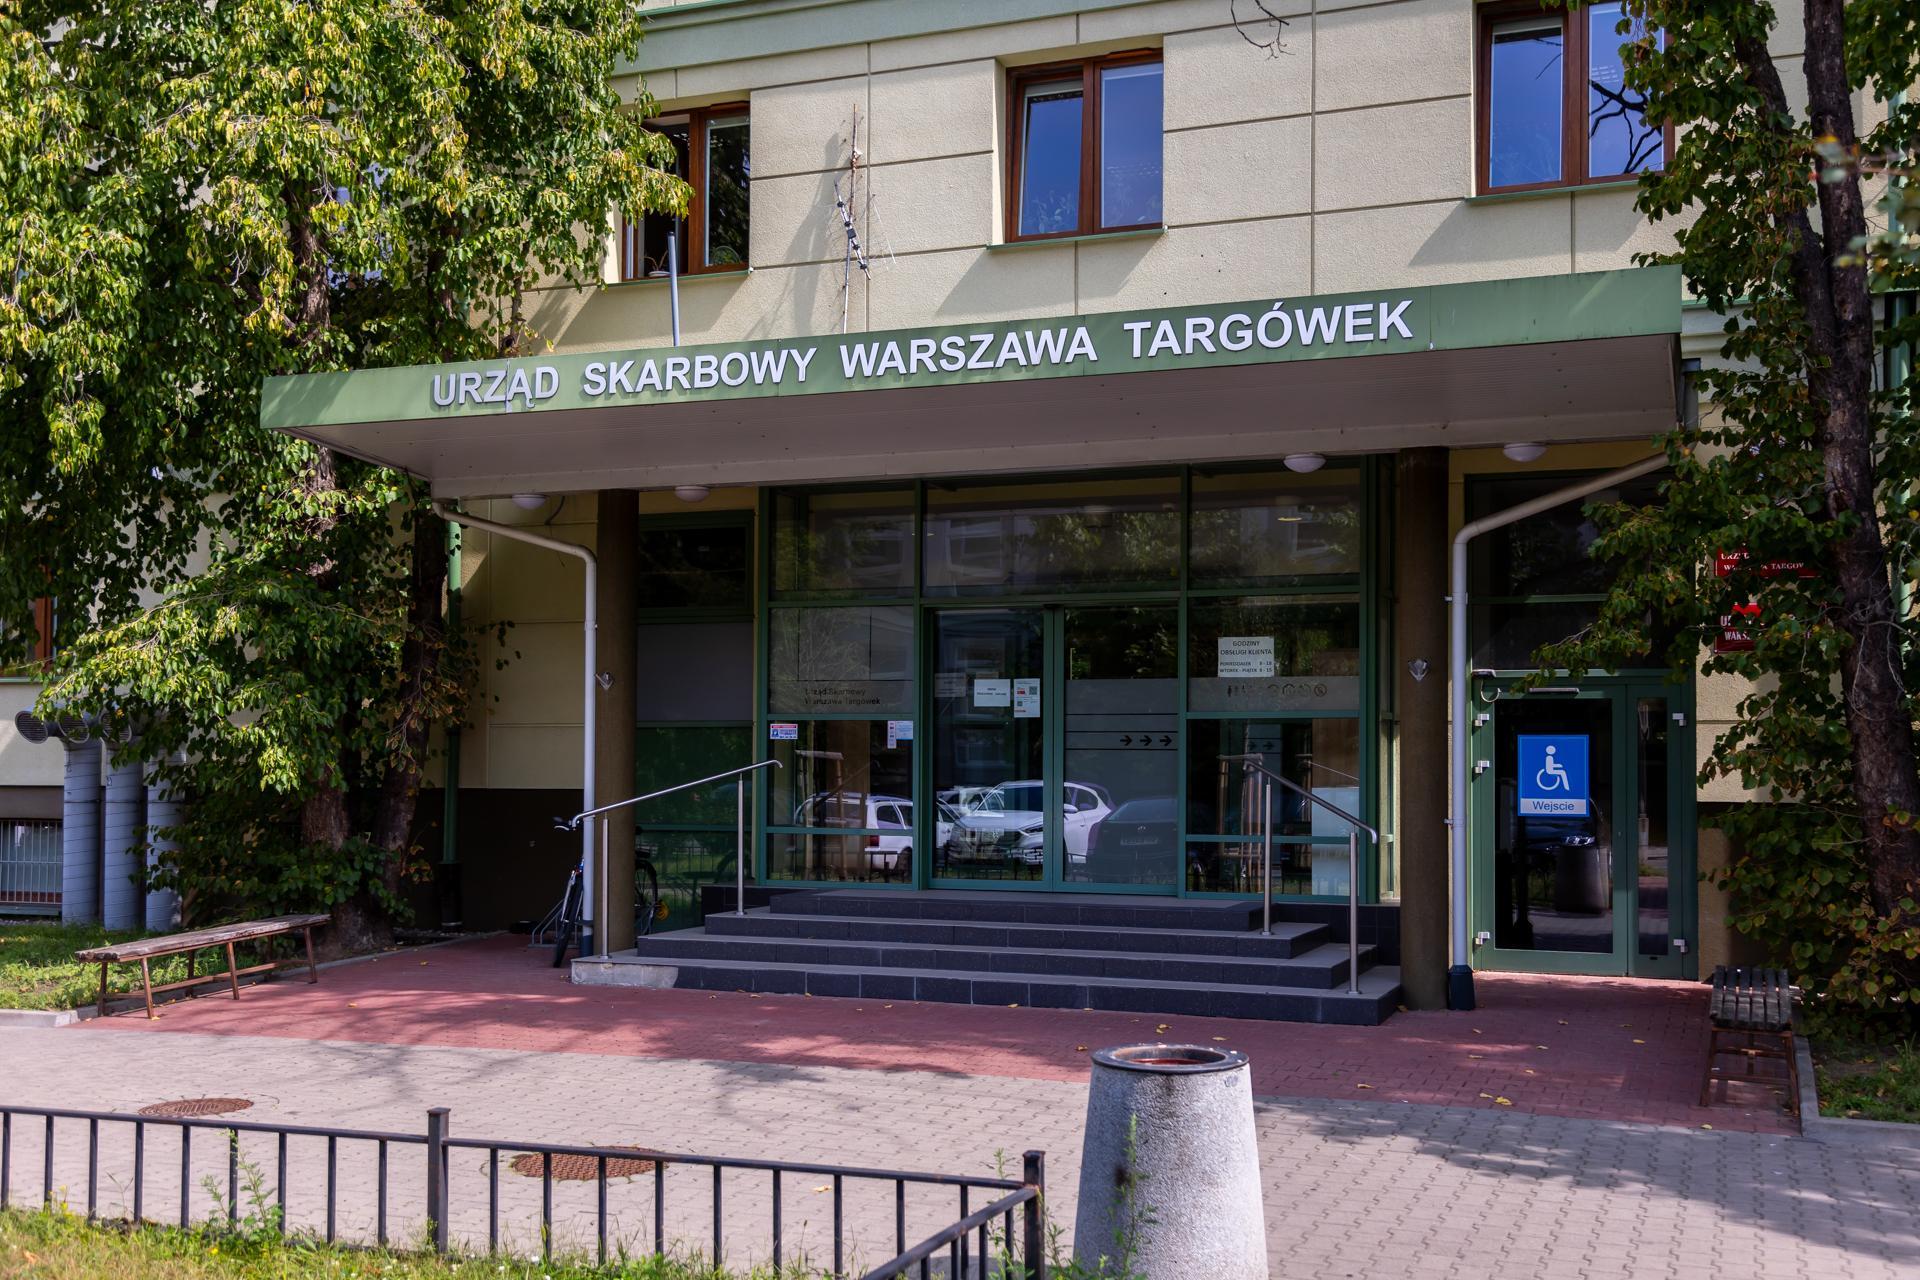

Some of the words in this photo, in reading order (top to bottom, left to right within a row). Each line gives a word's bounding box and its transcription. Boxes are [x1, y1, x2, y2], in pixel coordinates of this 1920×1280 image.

[433, 366, 560, 408] URZĄD
[584, 348, 817, 395] SKARBOWY
[839, 325, 1098, 378] WARSZAWA
[1123, 300, 1415, 358] TARGÓWEK
[1532, 800, 1575, 813] Wejscie
